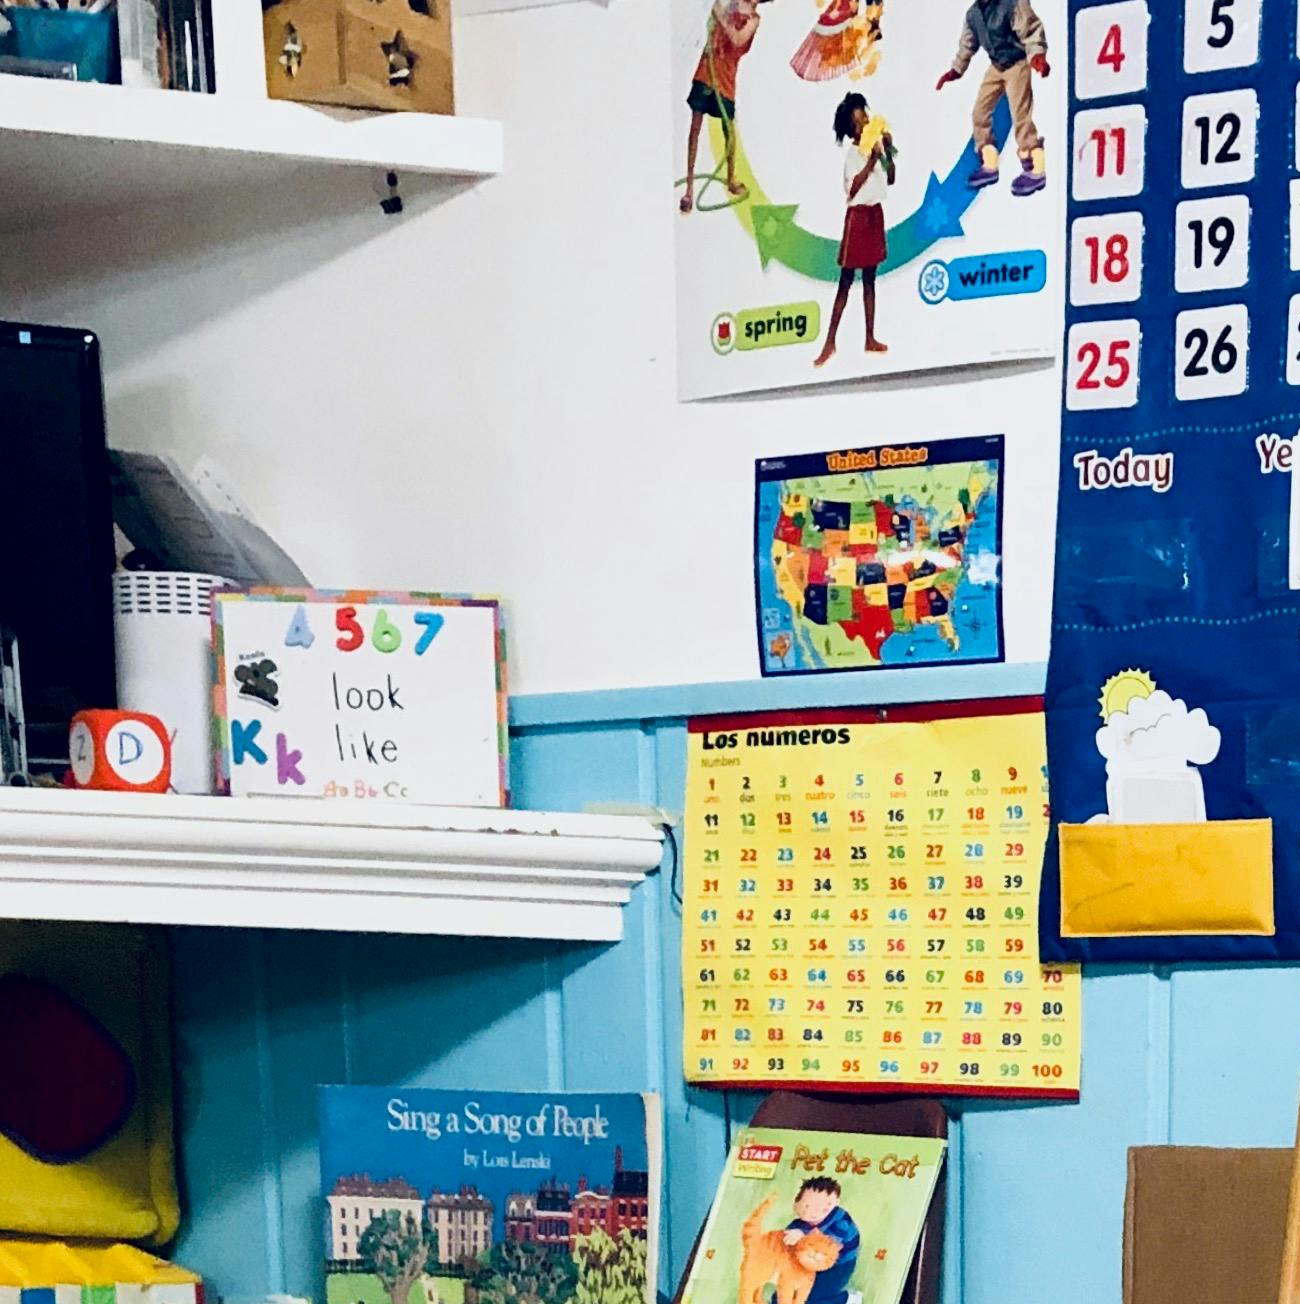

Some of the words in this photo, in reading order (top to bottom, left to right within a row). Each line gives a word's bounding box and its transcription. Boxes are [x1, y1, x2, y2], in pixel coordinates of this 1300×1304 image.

[1096, 24, 1126, 74] 4
[1207, 0, 1234, 48] 5
[1091, 128, 1125, 178] 11
[1194, 113, 1241, 165] 12
[1085, 234, 1129, 284] 18
[1188, 217, 1235, 268] 19
[959, 262, 1033, 285] winter
[744, 311, 807, 339] spring
[1077, 340, 1130, 390] 25
[1184, 325, 1238, 377] 26
[827, 454, 876, 471] United
[880, 447, 928, 464] States
[1076, 453, 1173, 489] Today
[336, 606, 364, 652] 5
[372, 609, 401, 653] 6
[413, 611, 444, 656] 7
[333, 672, 404, 711] look
[118, 731, 143, 765] D
[231, 720, 268, 765] K
[335, 724, 398, 765] like
[702, 731, 738, 750] Los
[387, 1099, 441, 1140] Sing
[446, 1113, 459, 1133] a
[464, 1102, 522, 1143] Song
[525, 1104, 549, 1136] of
[553, 1104, 609, 1145] People
[463, 1149, 480, 1168] by
[741, 1150, 779, 1160] START
[790, 1144, 830, 1172] Pet
[835, 1149, 871, 1174] the
[879, 1154, 919, 1178] Cat
